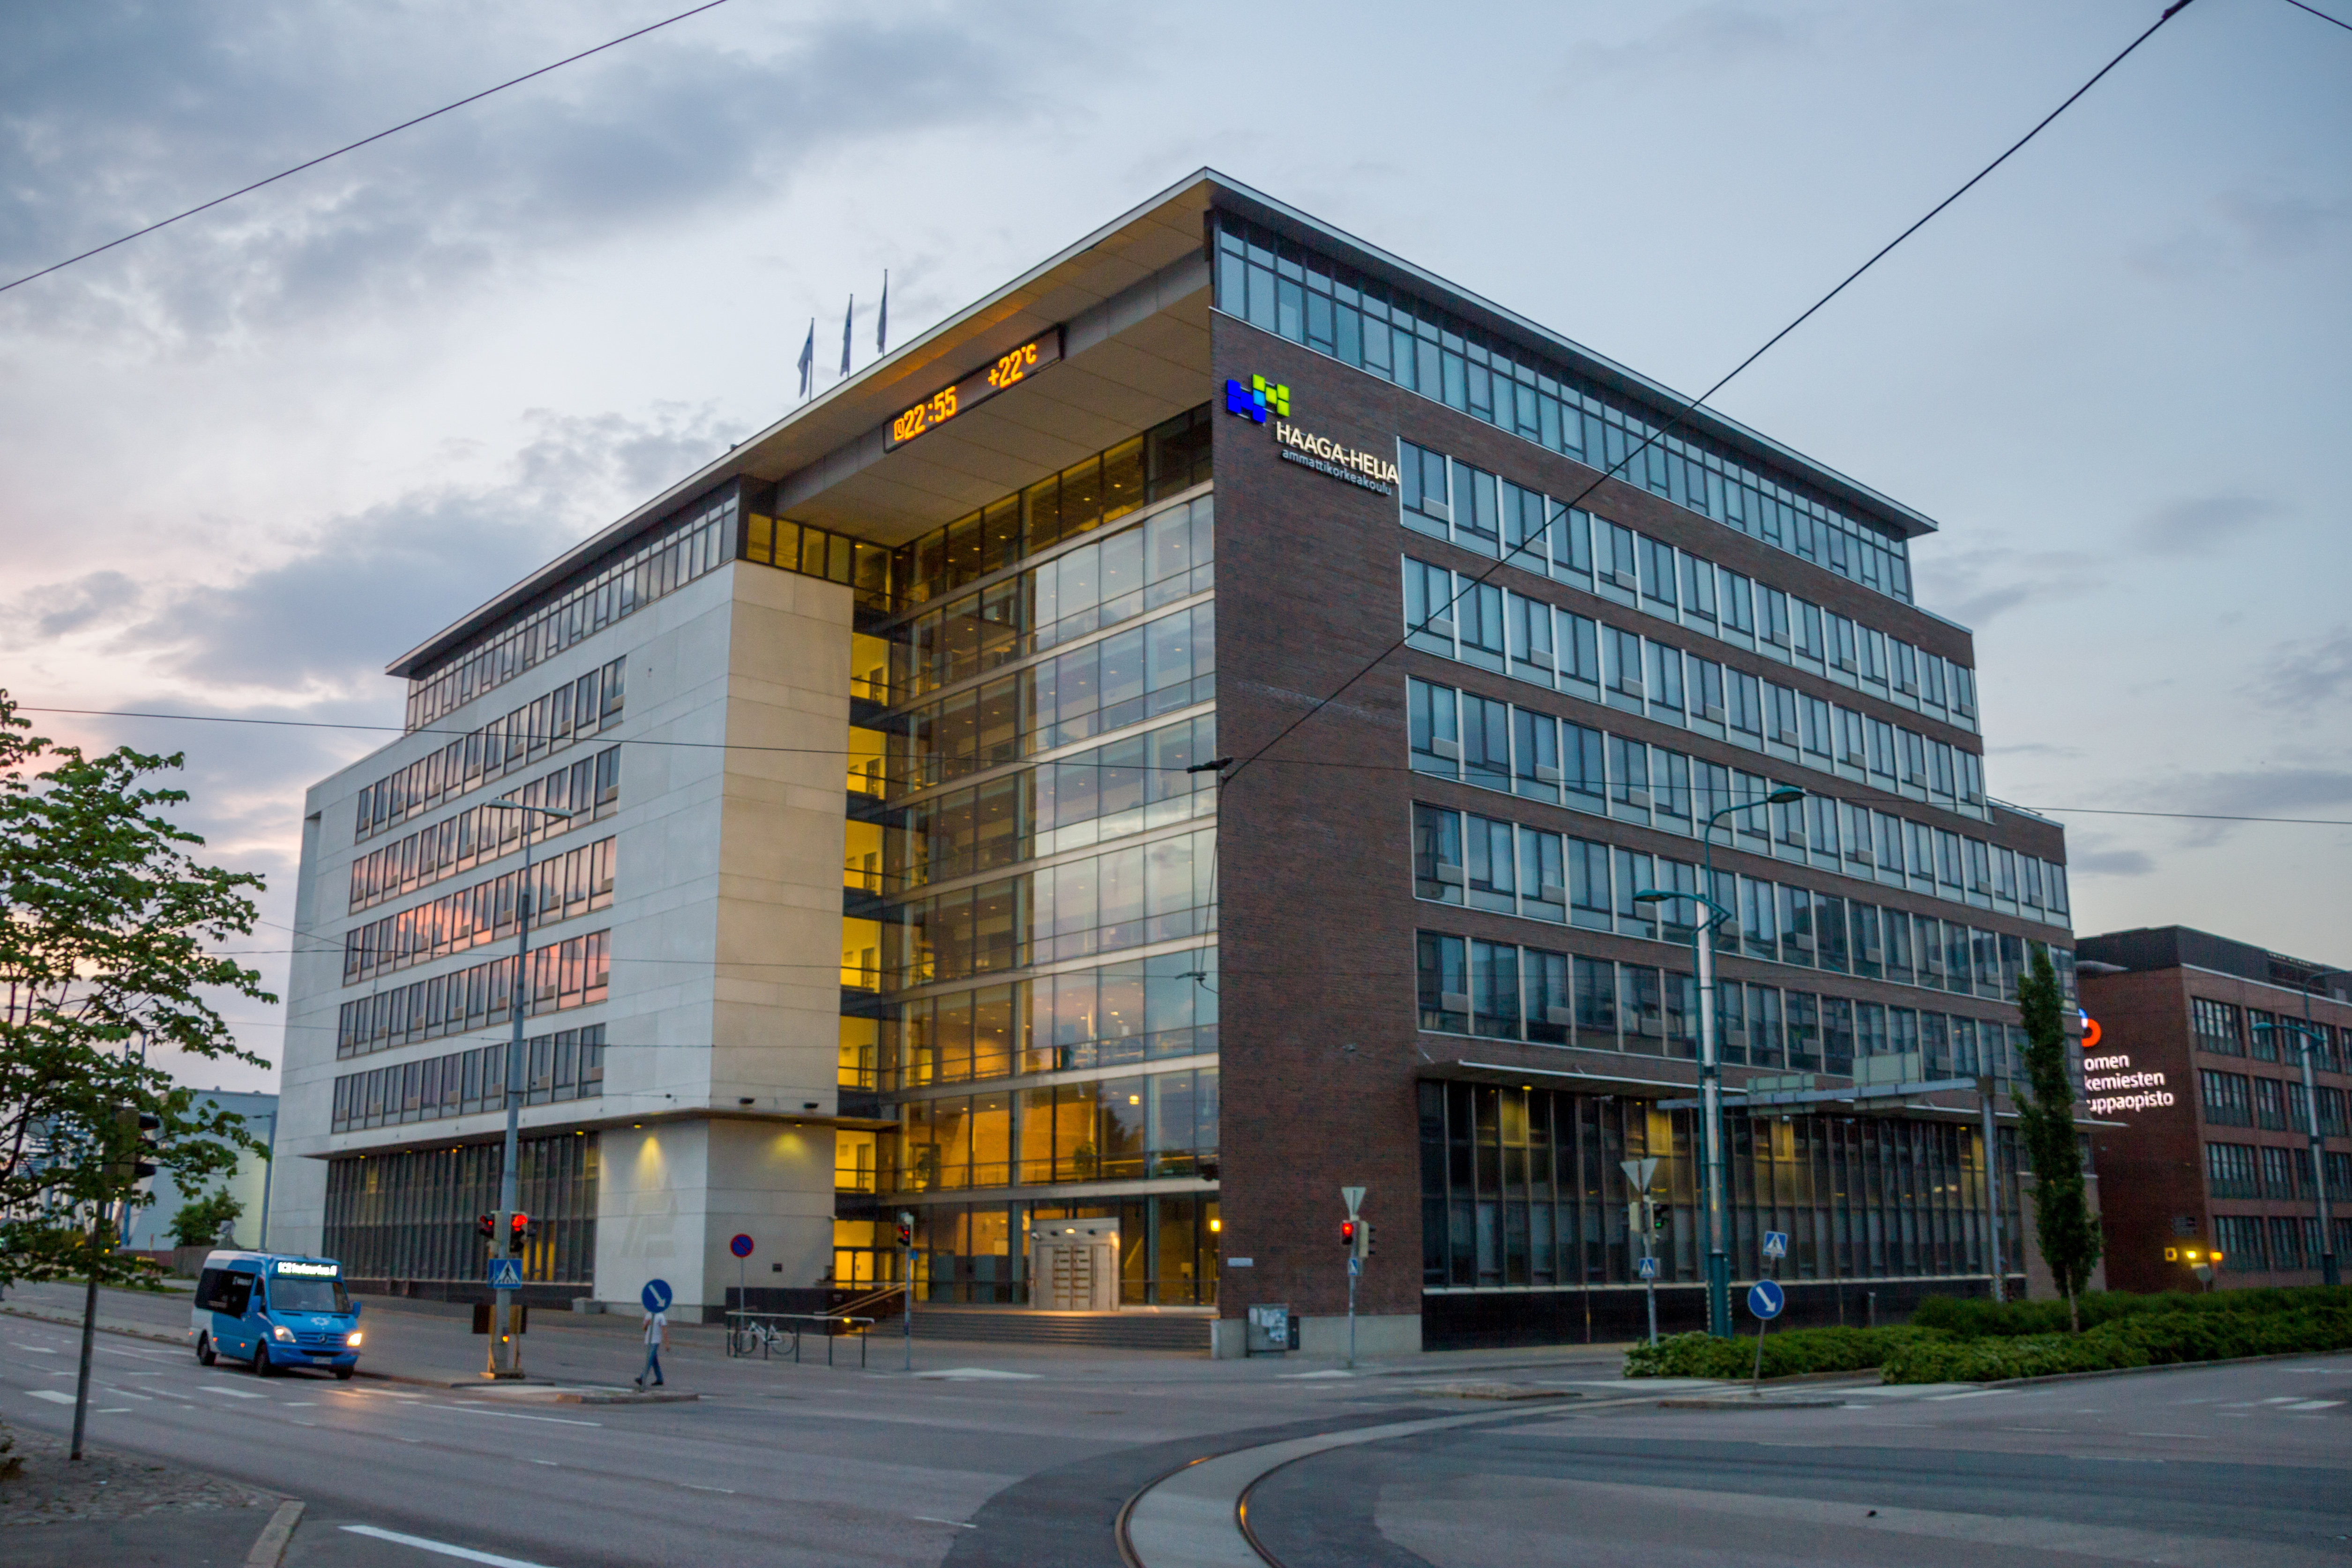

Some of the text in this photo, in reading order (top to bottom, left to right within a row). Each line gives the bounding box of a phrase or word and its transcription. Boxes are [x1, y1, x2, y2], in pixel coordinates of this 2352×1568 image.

[1277, 421, 1399, 484] HAAGA-HELIA
[1282, 448, 1392, 495] ammattikorkeakoulu
[2083, 1054, 2130, 1071] omen
